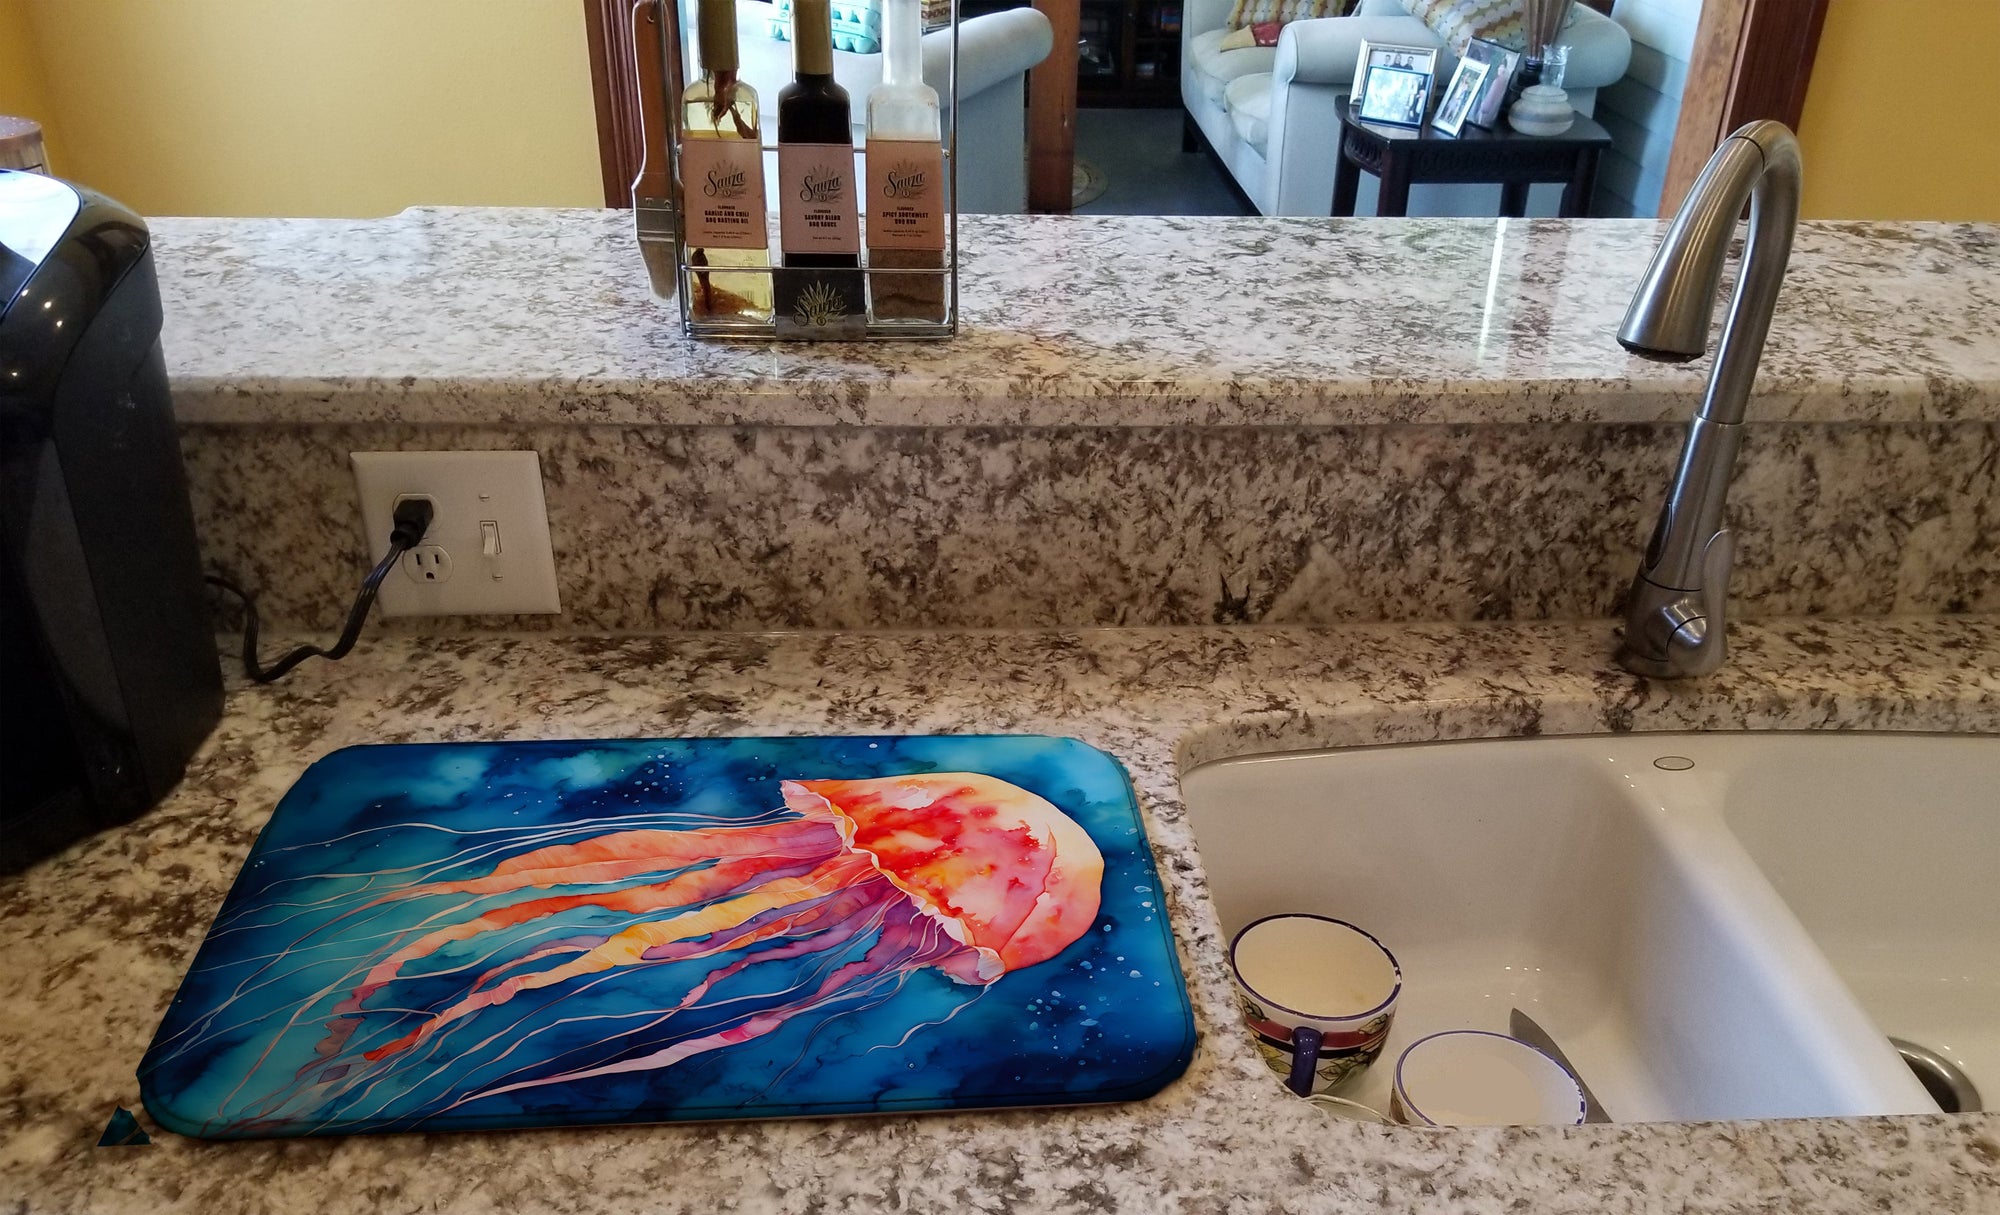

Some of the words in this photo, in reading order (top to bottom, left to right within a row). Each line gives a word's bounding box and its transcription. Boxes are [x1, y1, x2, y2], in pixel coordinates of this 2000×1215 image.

[704, 170, 745, 197] Sauza
[800, 175, 841, 202] Sauza
[883, 171, 924, 198] Sauza
[793, 296, 845, 326] Sauza
